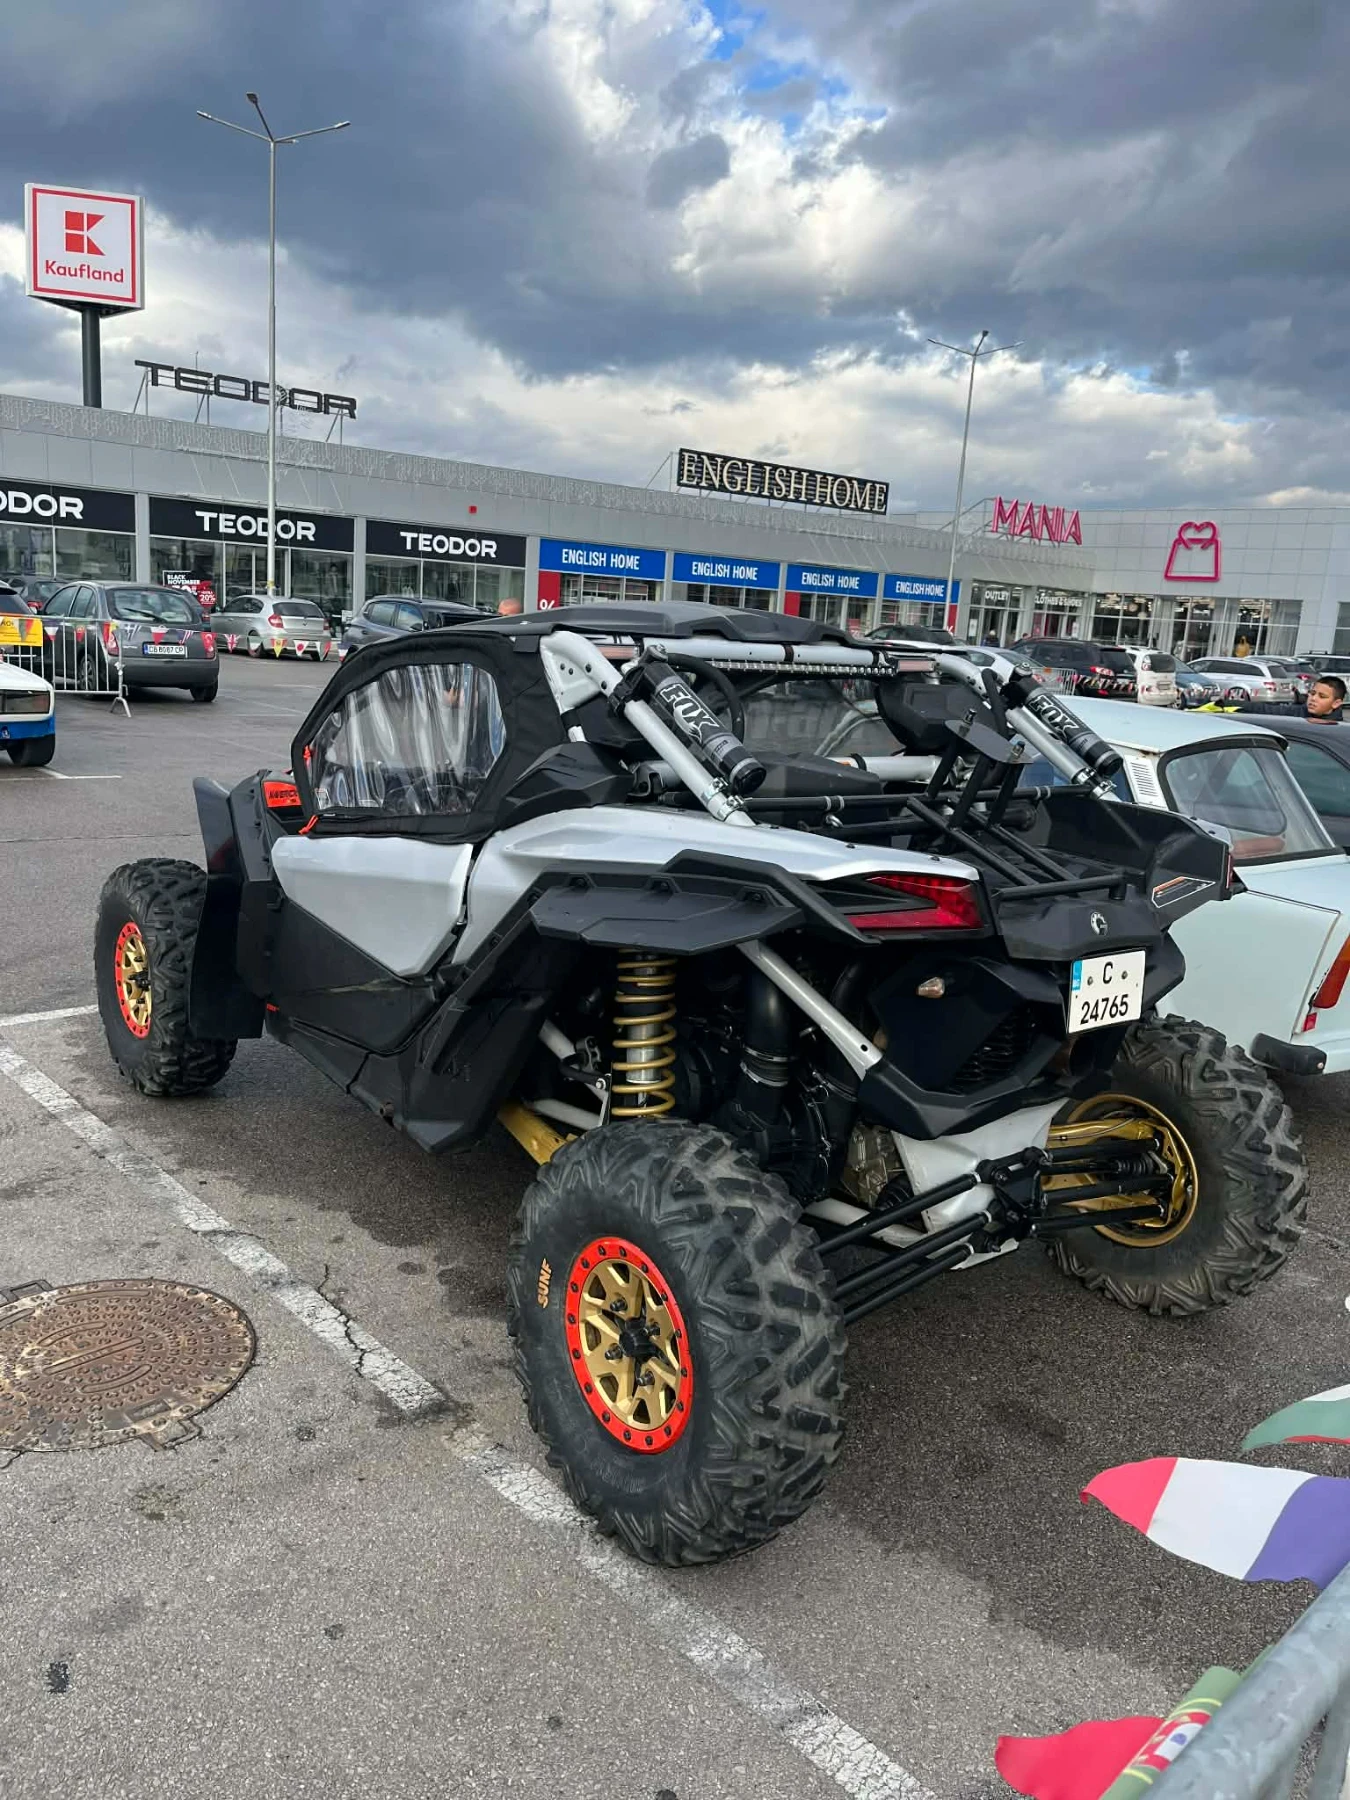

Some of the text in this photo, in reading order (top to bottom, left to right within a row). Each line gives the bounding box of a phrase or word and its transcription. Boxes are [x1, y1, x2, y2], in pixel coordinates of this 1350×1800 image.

[44, 259, 125, 284] Kaufland
[134, 359, 358, 420] TEODOR
[680, 452, 888, 513] ENGLISH HOME
[194, 510, 317, 541] TEODOR
[991, 495, 1082, 545] MANIA
[399, 531, 498, 558] TEODOR
[561, 548, 641, 571] ENGLISH HOME
[691, 561, 759, 581] ENGLISH HOME
[800, 571, 861, 590] ENGLISH HOME
[894, 580, 945, 598] ENGLISH HOME
[984, 589, 1010, 601] OUTLET
[660, 683, 720, 743] FOX
[1029, 694, 1080, 742] FOX
[1102, 961, 1114, 985] C
[1080, 993, 1129, 1026] 24765
[537, 1257, 552, 1309] SUNF
